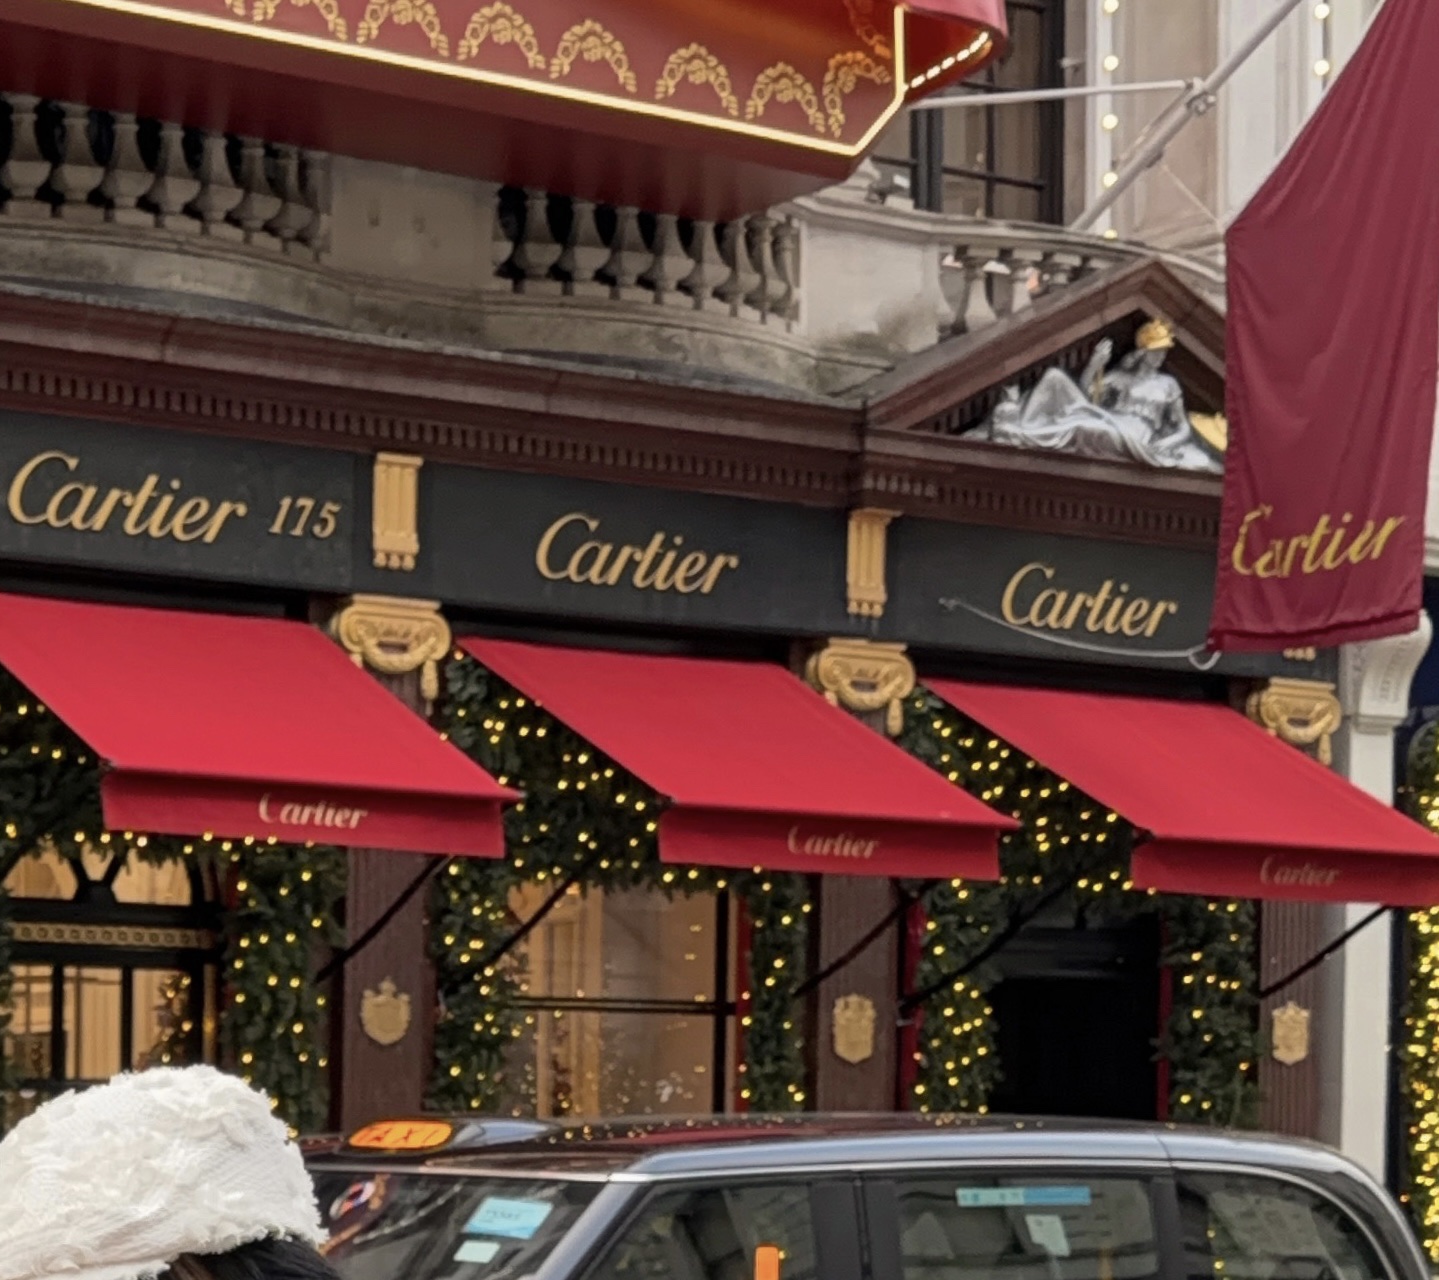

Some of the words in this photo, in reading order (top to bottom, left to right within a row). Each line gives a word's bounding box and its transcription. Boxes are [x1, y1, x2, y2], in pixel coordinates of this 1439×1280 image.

[7, 451, 248, 544] Cartier
[269, 496, 341, 539] 175
[535, 512, 738, 594] Cartier
[1231, 502, 1406, 579] Cartier
[1001, 562, 1177, 638] Cartier
[258, 792, 368, 830] Cartier
[786, 824, 879, 860] Cartier
[1260, 855, 1340, 888] Cartier
